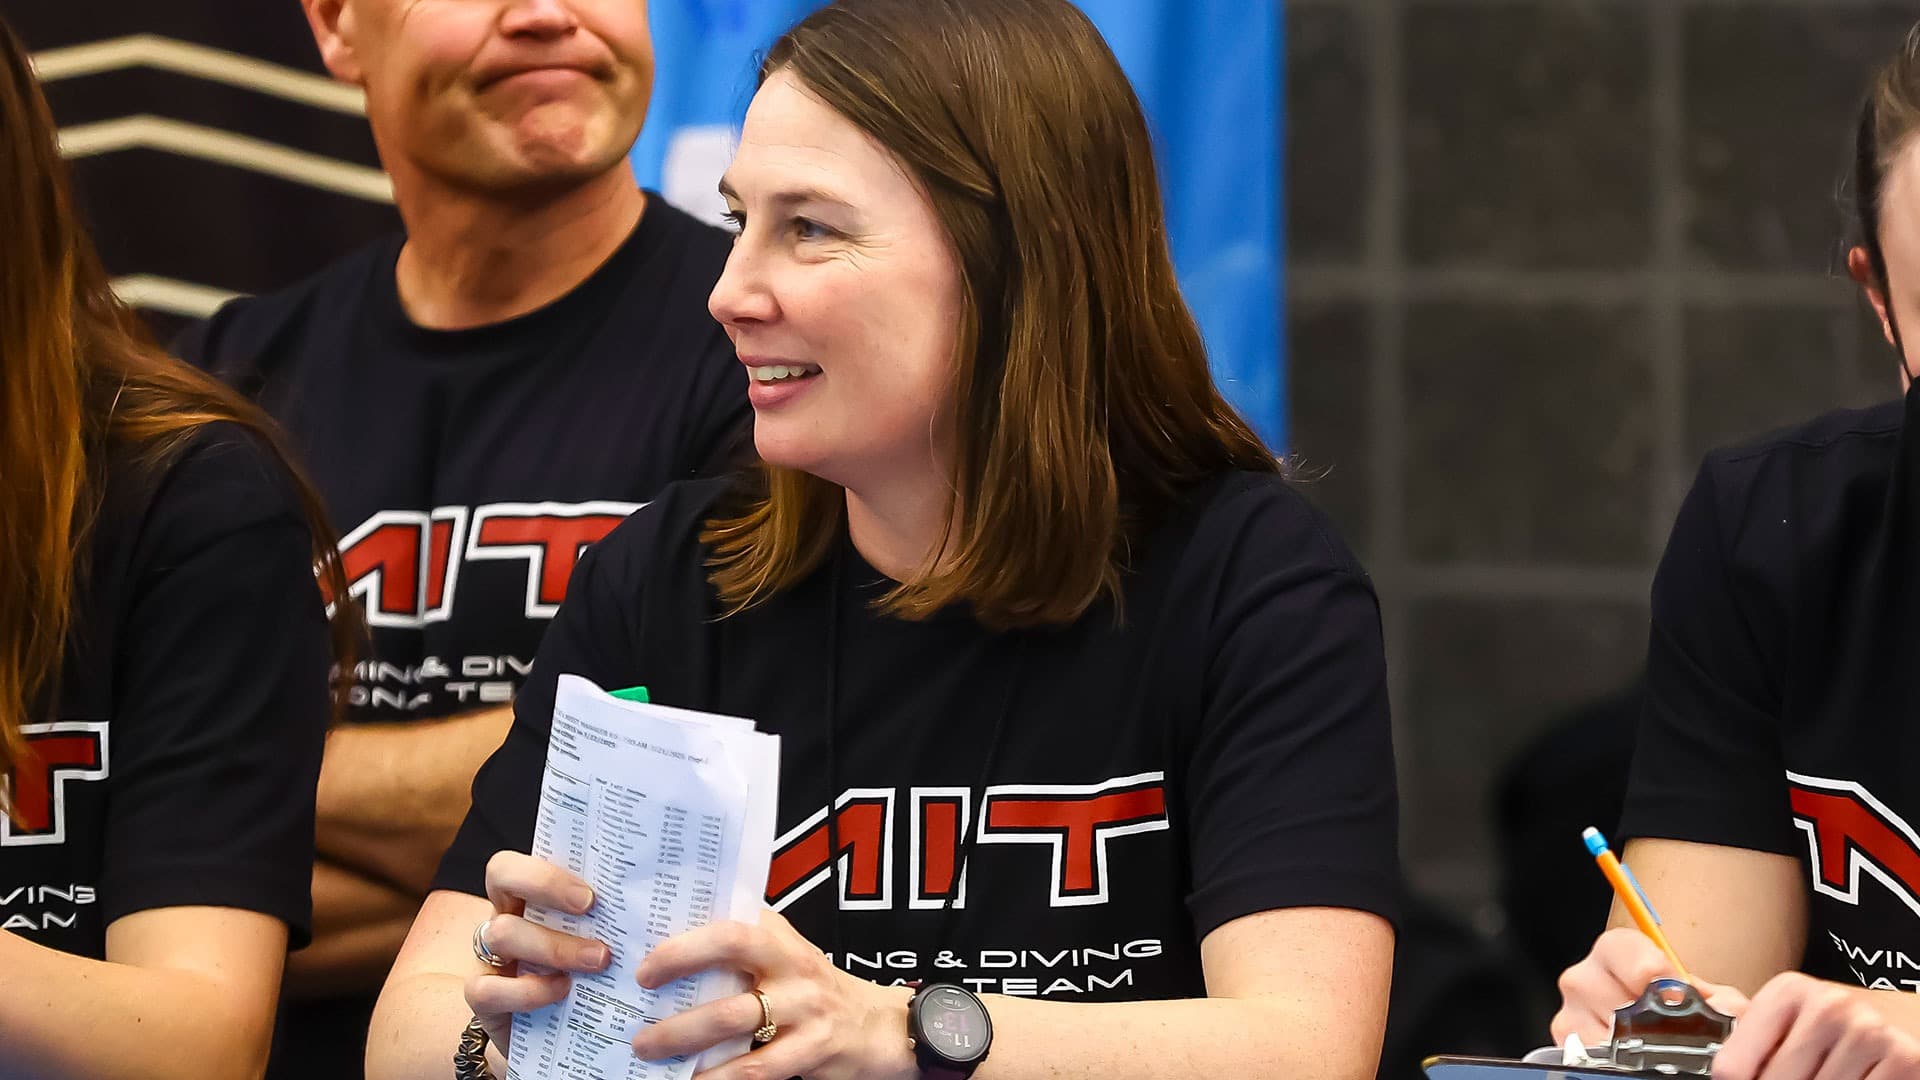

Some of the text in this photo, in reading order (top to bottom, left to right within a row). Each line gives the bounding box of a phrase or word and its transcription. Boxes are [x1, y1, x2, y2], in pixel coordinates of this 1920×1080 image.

[934, 950, 968, 968] &
[980, 939, 1162, 968] DIVING
[963, 969, 1133, 996] TEAM
